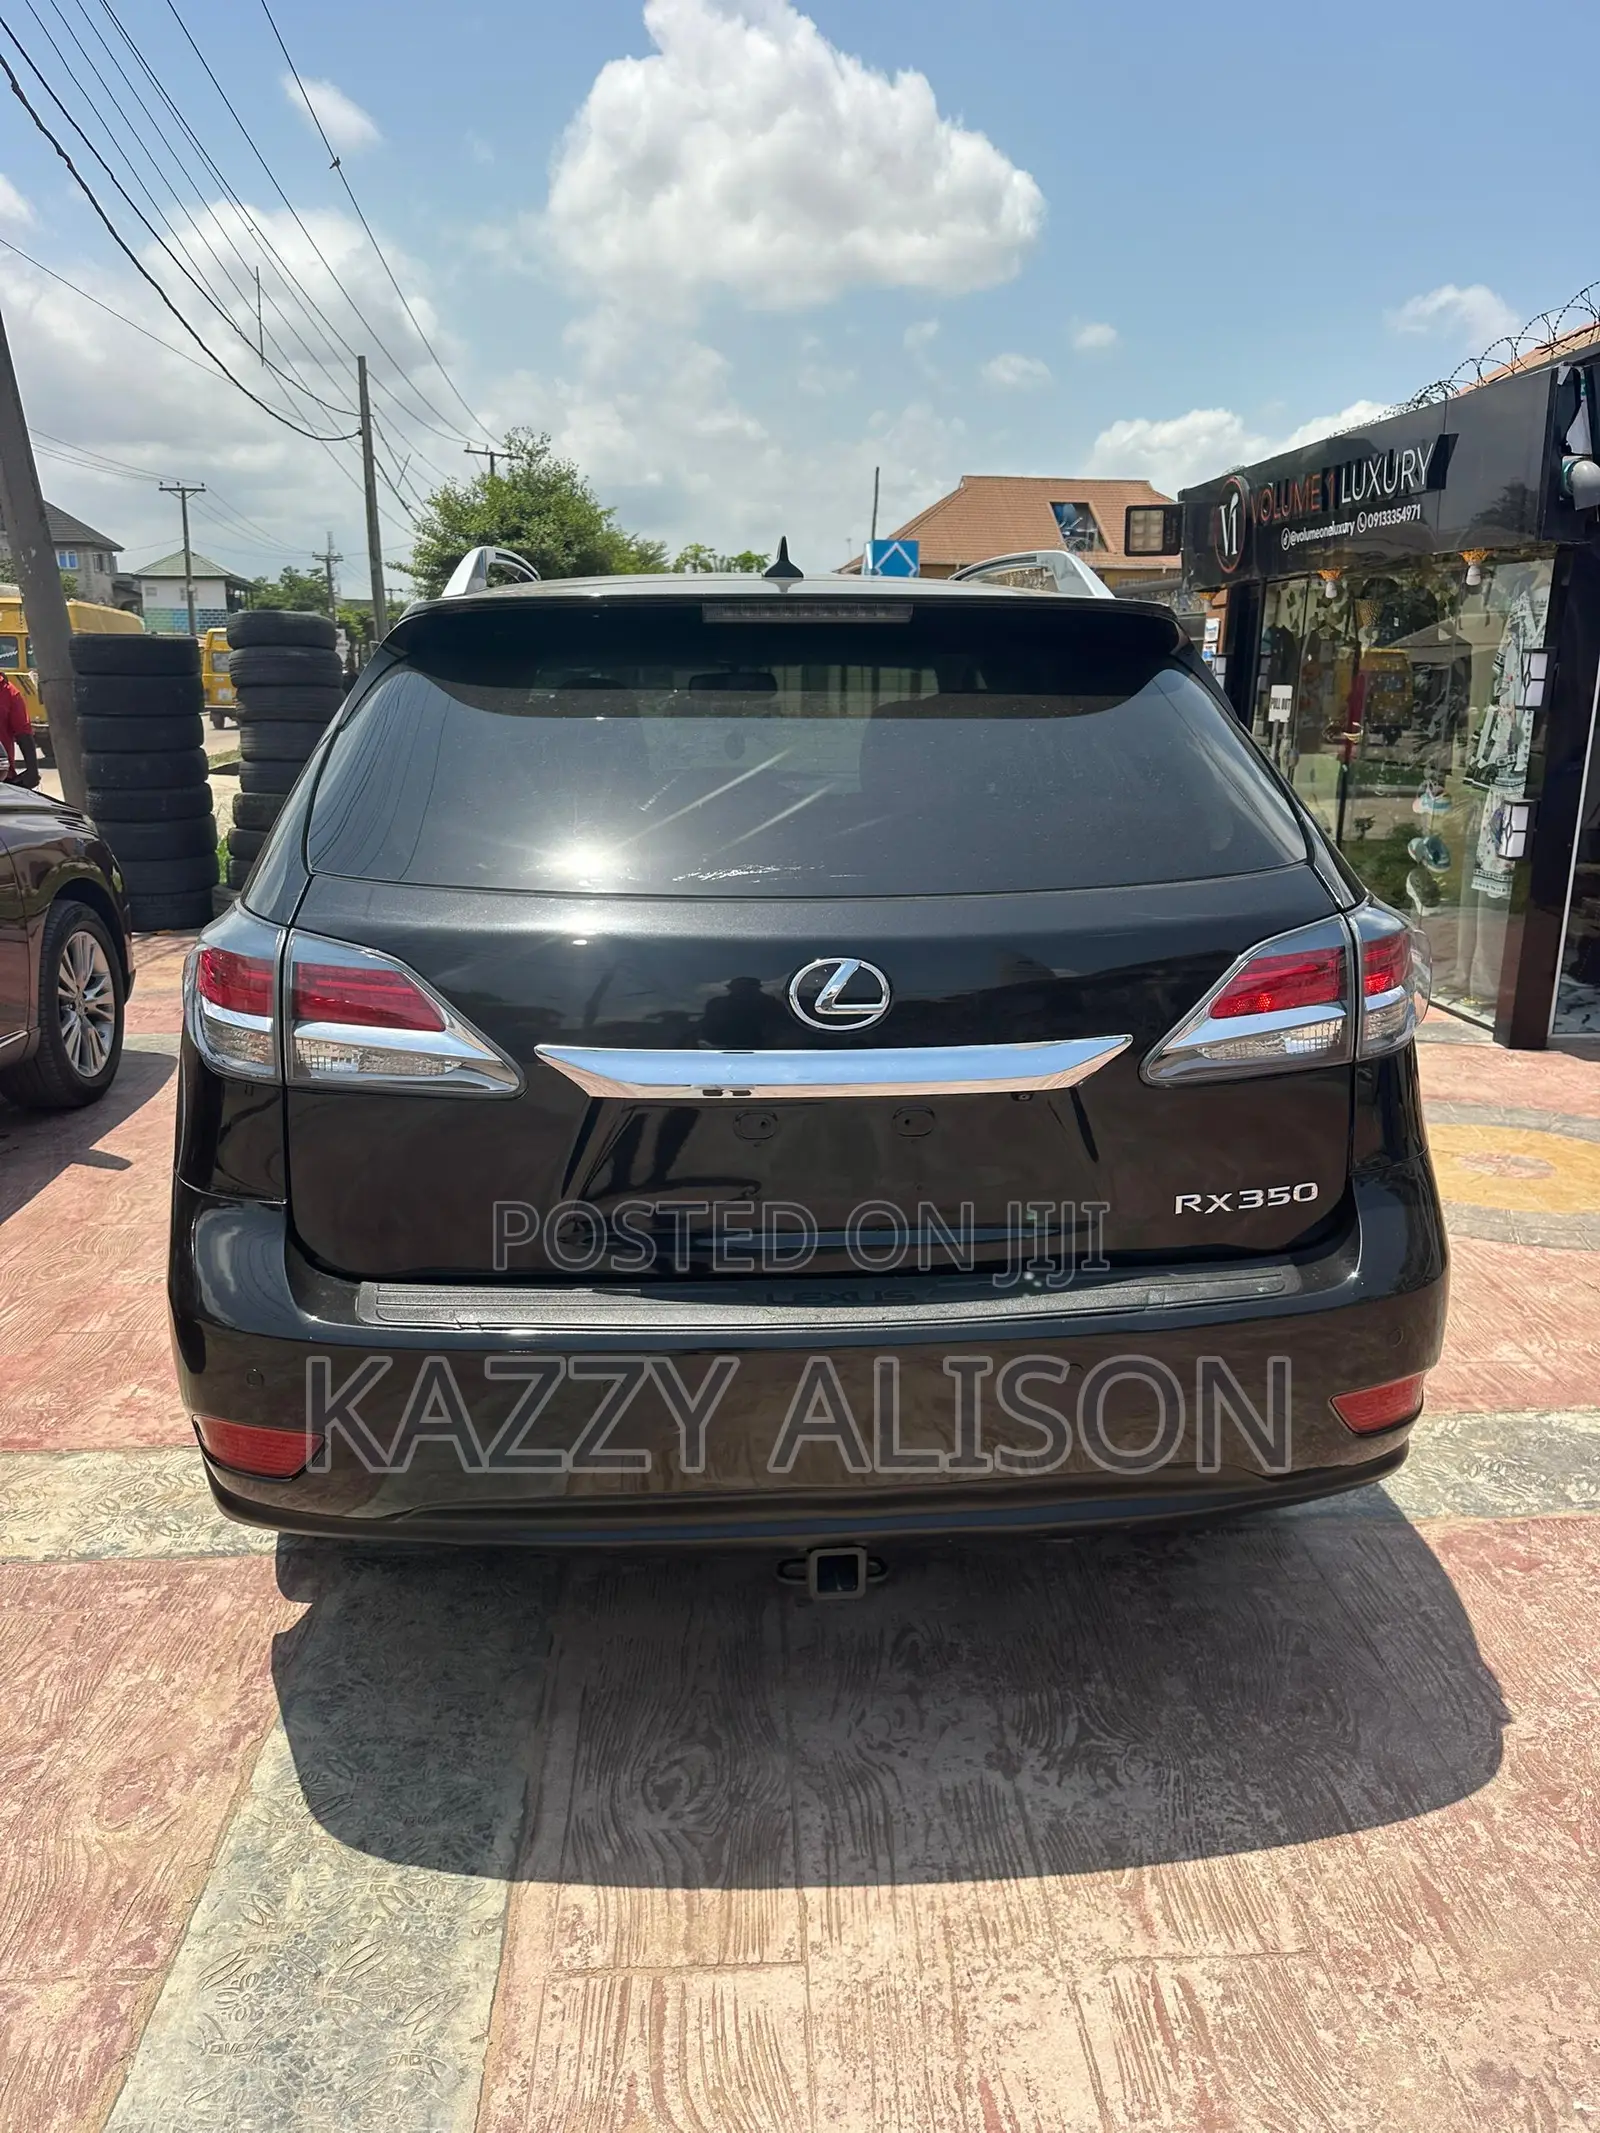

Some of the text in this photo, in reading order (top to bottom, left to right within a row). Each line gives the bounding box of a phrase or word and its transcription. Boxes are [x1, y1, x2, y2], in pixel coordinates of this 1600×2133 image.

[1251, 472, 1321, 525] VOLUME
[1341, 442, 1434, 504] LUXURY
[1289, 503, 1421, 546] @volumeoneluxury 09133354971
